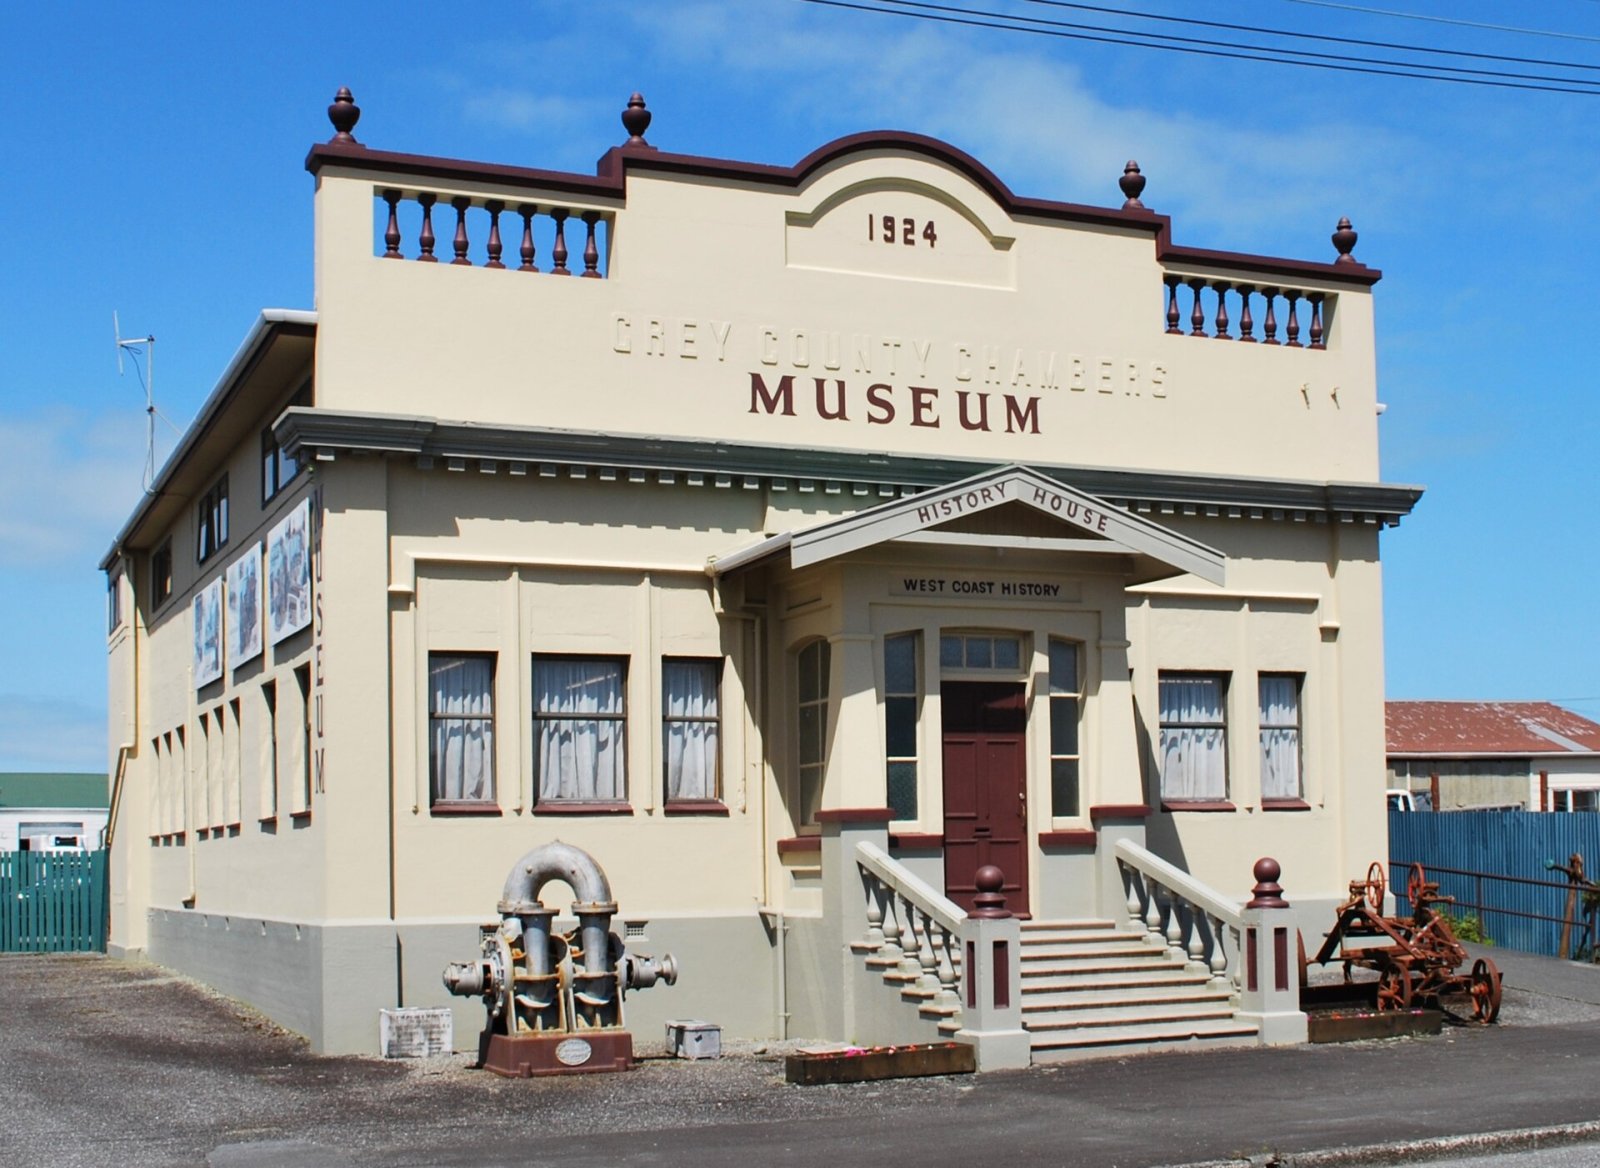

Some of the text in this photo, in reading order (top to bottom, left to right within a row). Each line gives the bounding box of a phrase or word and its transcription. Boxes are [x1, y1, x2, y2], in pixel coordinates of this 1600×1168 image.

[869, 213, 937, 248] 1924
[612, 310, 1168, 398] GREY COUNTY CHAMBERS
[747, 372, 1042, 434] MUSEUM
[917, 482, 1109, 532] HISTORY HOUSE
[904, 579, 1060, 596] WEST COAST HISTORY
[314, 483, 325, 794] MUSEUM
